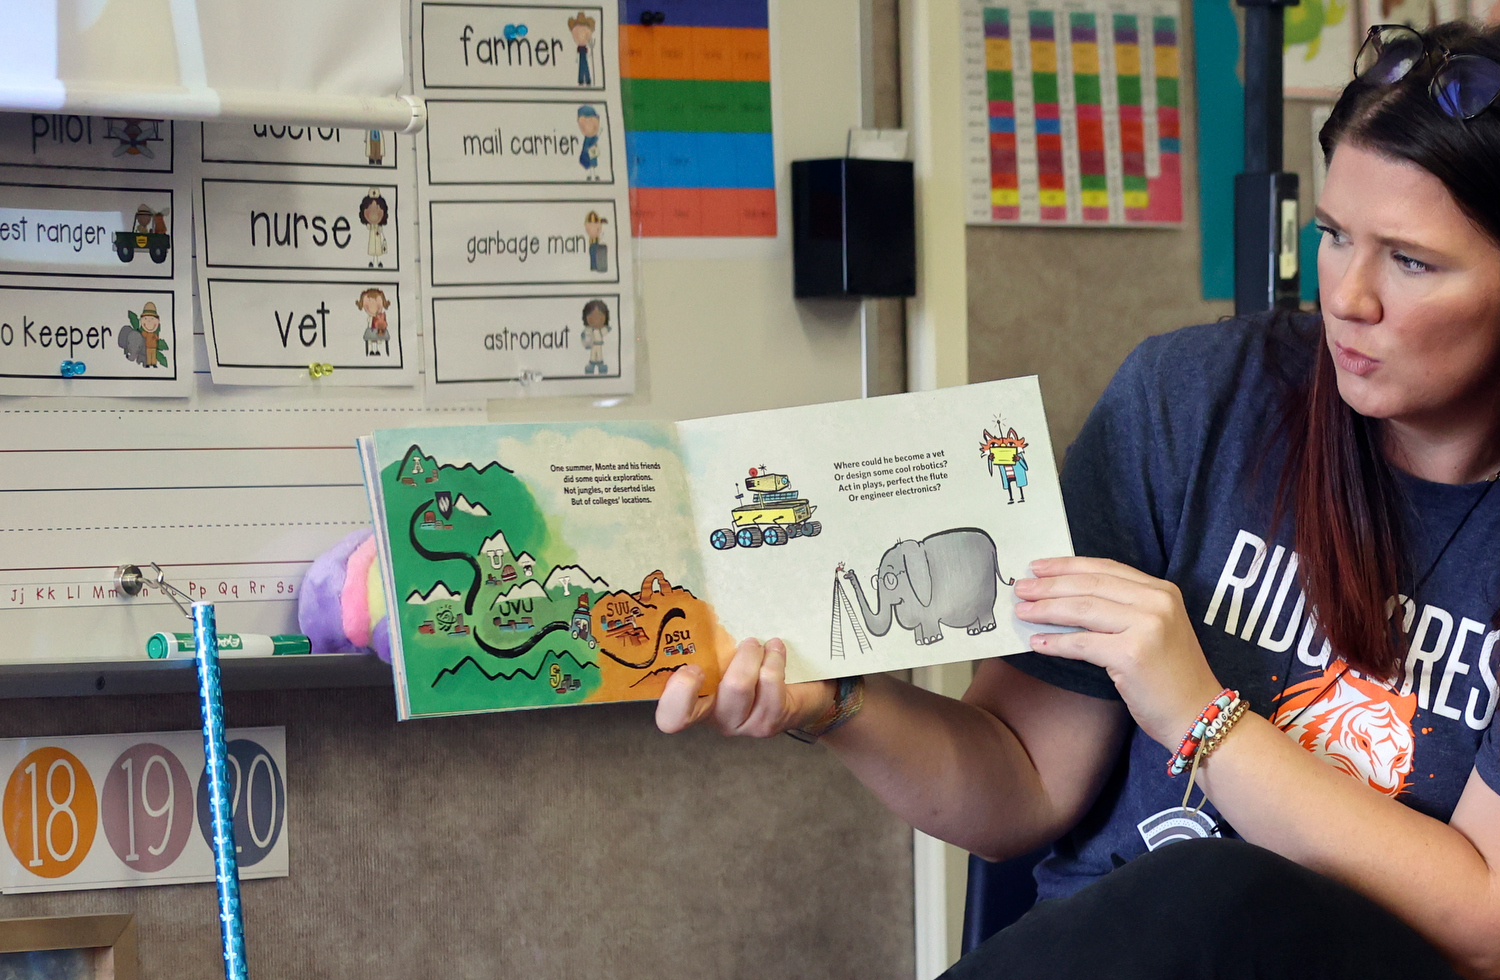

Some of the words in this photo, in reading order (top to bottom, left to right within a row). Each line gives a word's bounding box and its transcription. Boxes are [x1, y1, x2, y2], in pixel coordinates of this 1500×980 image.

[460, 24, 563, 67] farmer
[463, 128, 503, 156] mail
[510, 129, 579, 156] carrier
[37, 223, 106, 252] ranger
[250, 210, 352, 249] nurse
[466, 230, 540, 263] garbage
[547, 233, 587, 255] man
[274, 301, 330, 348] vet
[24, 315, 112, 359] keeper
[484, 326, 571, 351] astronaut
[550, 464, 564, 472] One
[566, 464, 594, 472] summer,
[595, 463, 616, 471] Monte
[617, 462, 629, 470] and
[630, 462, 639, 470] his
[640, 462, 661, 470] friends
[833, 461, 860, 470] Where
[861, 457, 882, 467] could
[883, 456, 893, 464] he
[894, 453, 924, 463] become
[932, 450, 945, 458] vet
[564, 475, 574, 483] did
[575, 475, 593, 483] some
[594, 474, 612, 483] quick
[613, 473, 653, 483] explorations.
[834, 473, 844, 481] Or
[846, 470, 872, 480] design
[873, 469, 894, 477] some
[895, 465, 911, 474] cool
[912, 460, 948, 471] robotics?
[577, 486, 603, 495] jungles,
[613, 485, 641, 493] deserted
[838, 484, 852, 492] Act
[853, 482, 861, 490] in
[862, 480, 885, 491] plays,
[887, 476, 914, 487] perfect
[915, 474, 928, 483] the
[929, 472, 948, 481] flute
[571, 498, 583, 506] But
[584, 497, 592, 505] of
[592, 497, 621, 506] colleges'
[621, 496, 652, 504] locations.
[848, 494, 859, 502] Or
[860, 491, 894, 501] engineer
[895, 483, 941, 496] electronics?
[499, 598, 534, 616] UVU
[606, 601, 631, 617] SUU
[665, 630, 691, 644] DSU
[25, 758, 78, 867] 18
[121, 755, 175, 861] 19
